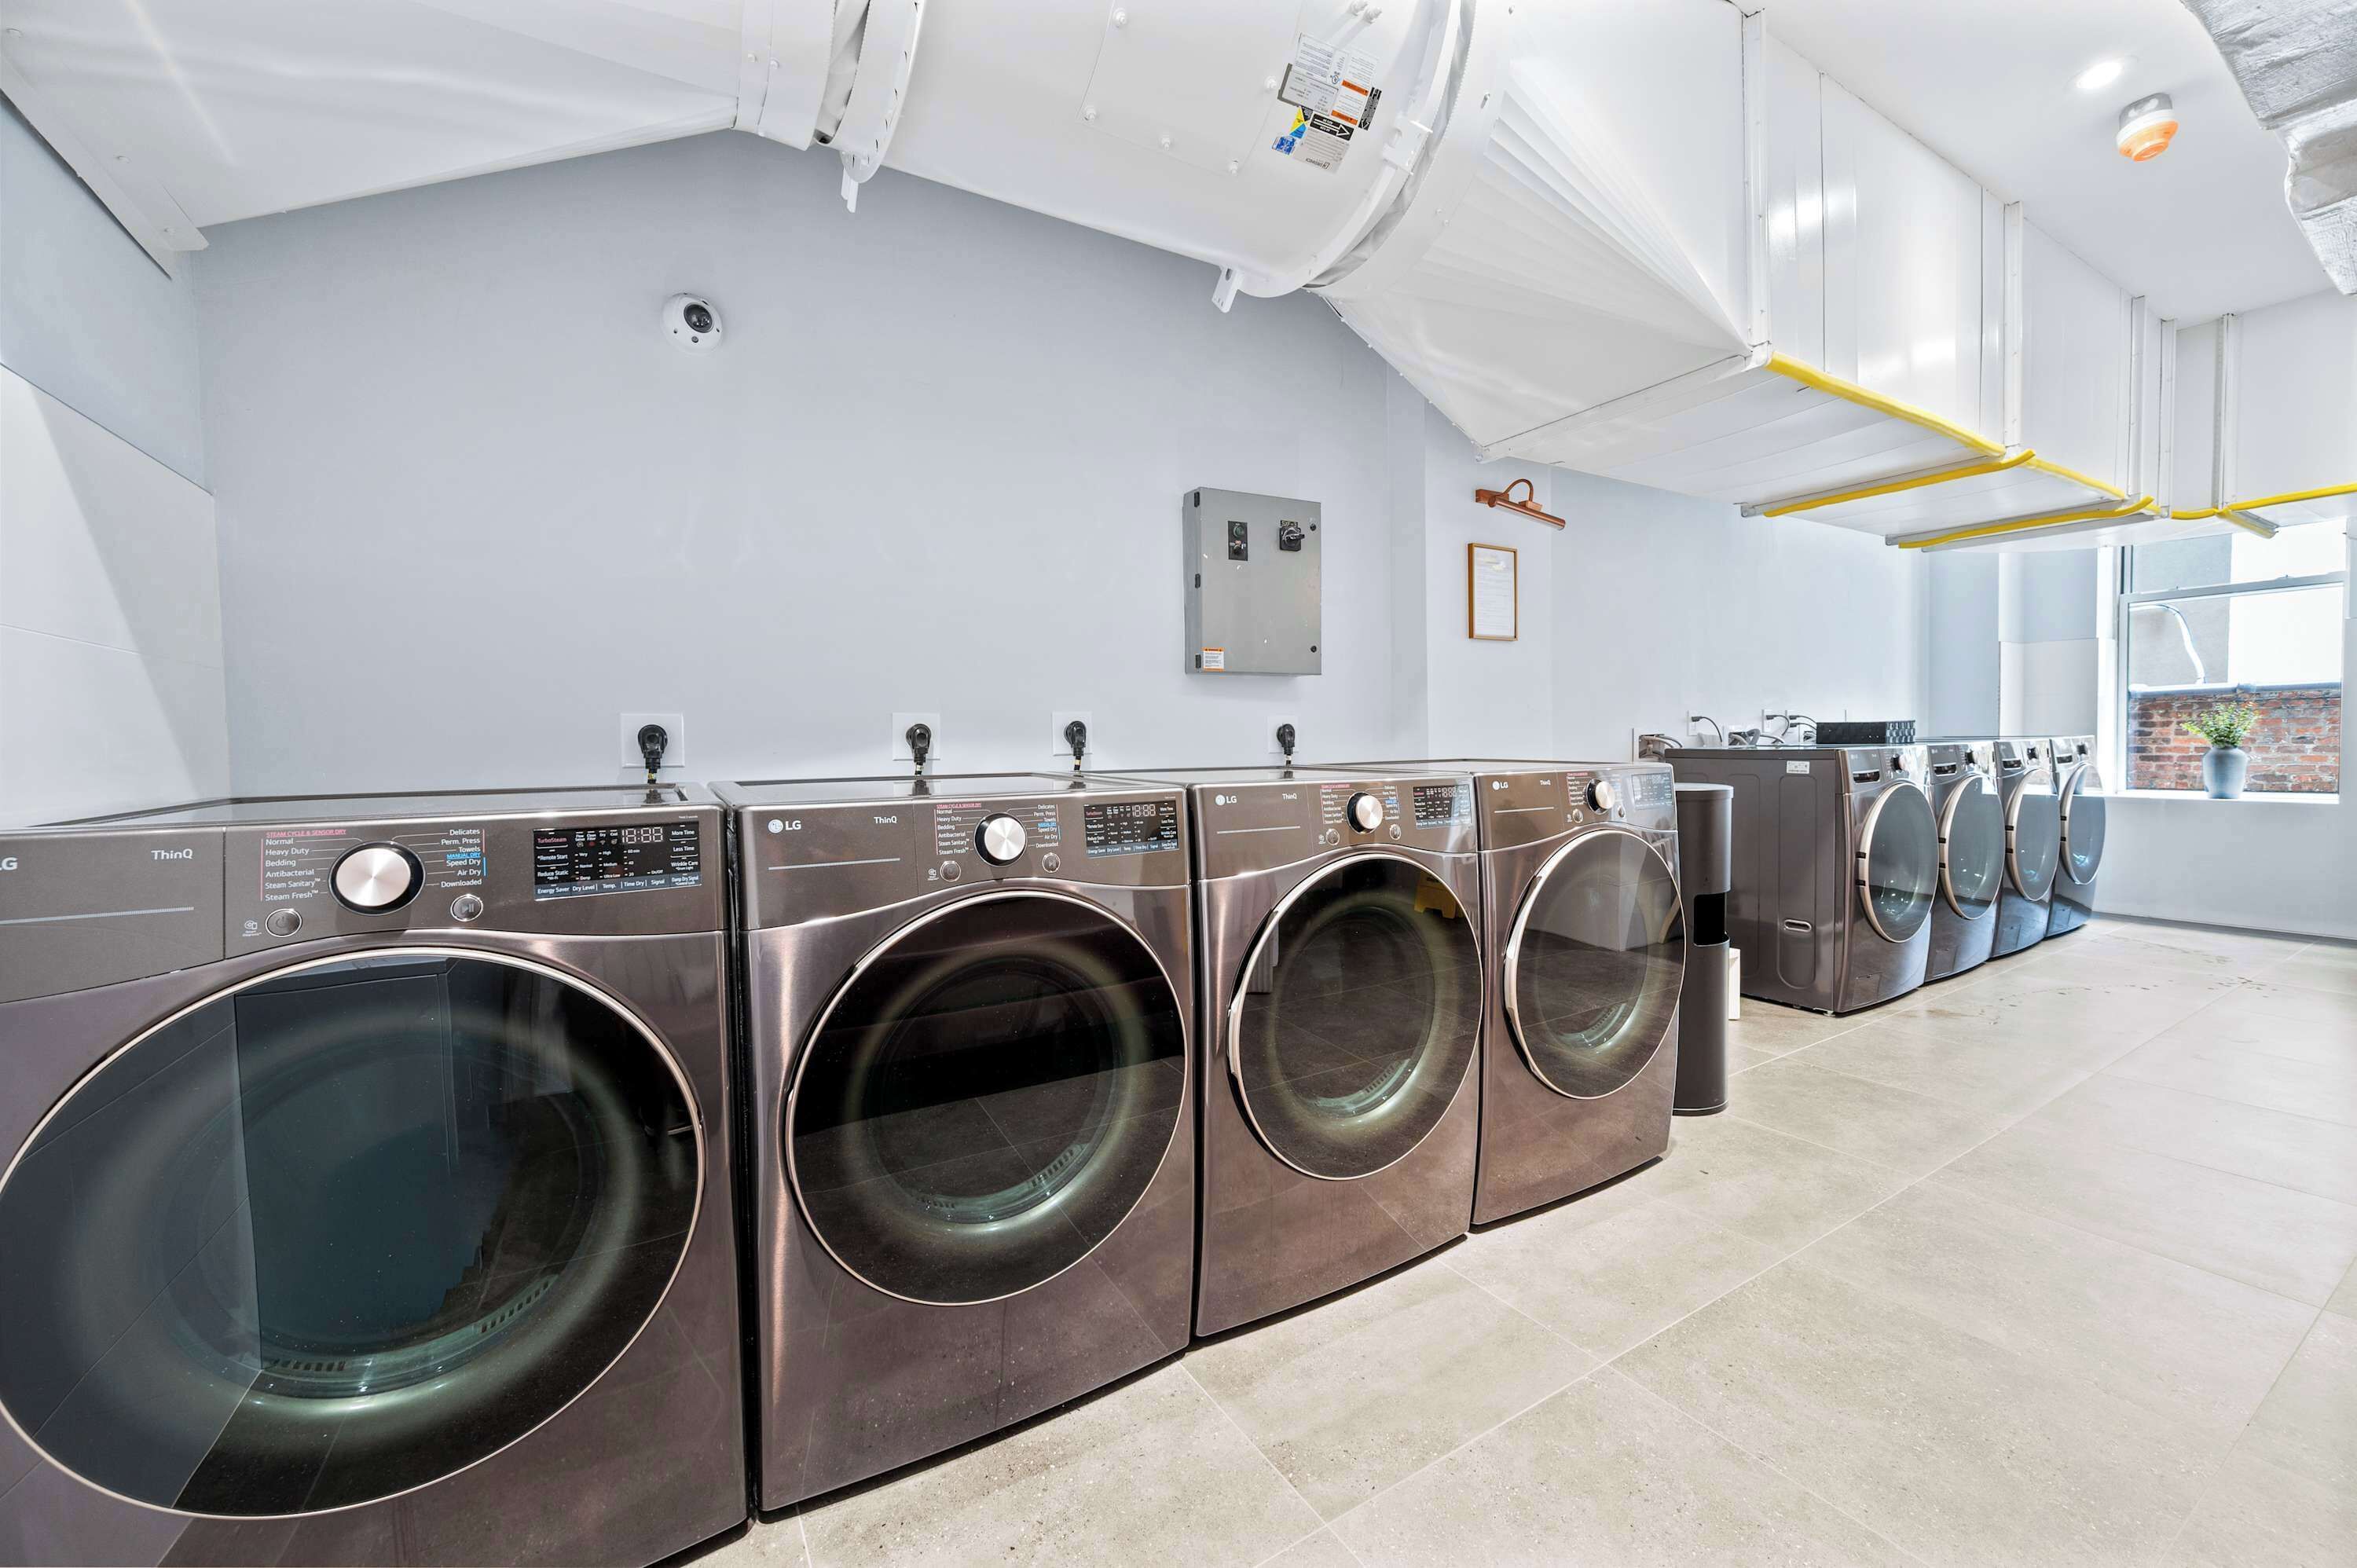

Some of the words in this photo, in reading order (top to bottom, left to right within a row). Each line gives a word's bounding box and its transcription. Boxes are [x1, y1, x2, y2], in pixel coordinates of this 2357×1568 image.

[874, 815, 897, 824] ThinQ
[786, 820, 801, 831] LG
[151, 848, 193, 860] ThinQ
[0, 857, 18, 870] G
[266, 869, 314, 877] Antibacterial
[441, 879, 482, 888] Downloaded
